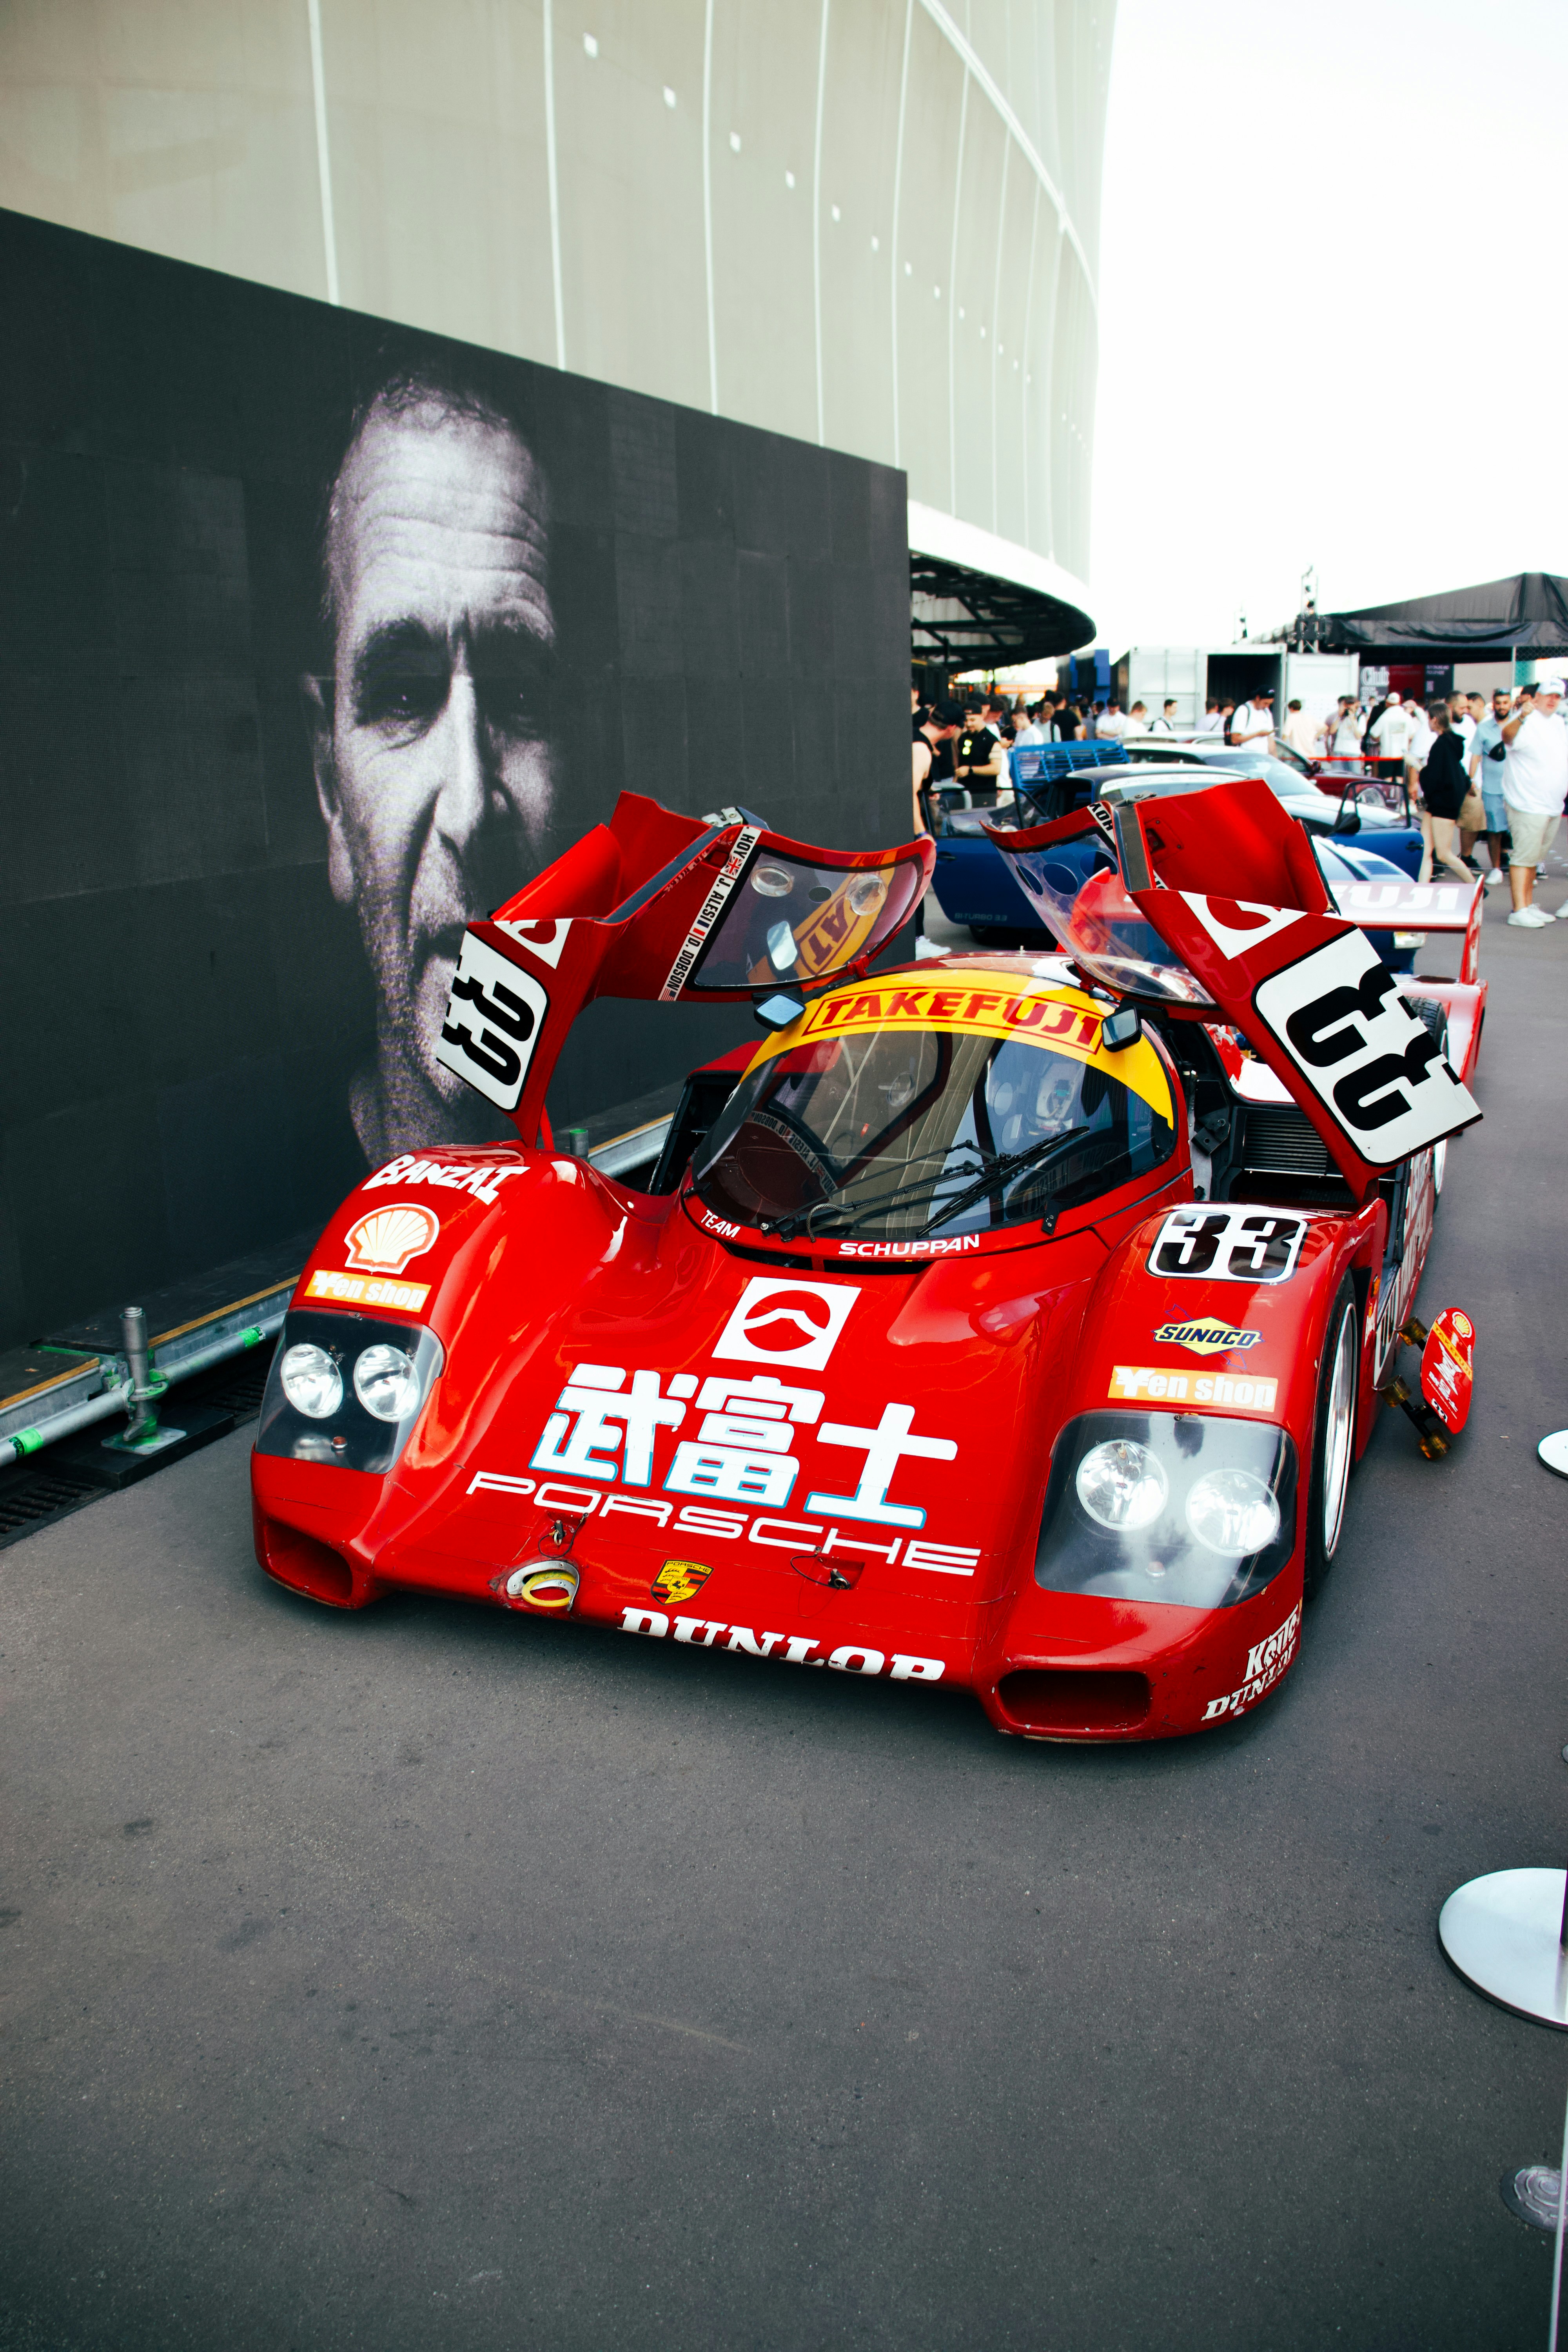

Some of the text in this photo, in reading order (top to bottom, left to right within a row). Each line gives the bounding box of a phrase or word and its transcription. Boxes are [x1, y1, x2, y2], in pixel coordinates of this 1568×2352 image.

[1361, 667, 1389, 686] Club
[1089, 803, 1113, 831] HOY
[733, 834, 755, 859] HOY
[700, 877, 731, 921] J. ALESI
[667, 936, 701, 991] D. DOBSON
[820, 989, 1101, 1045] TAKEFUJI
[361, 1154, 530, 1205] BANZAI
[701, 1209, 980, 1256] TEAM SCHUPPAN
[1156, 1210, 1301, 1279] 33
[365, 1281, 428, 1310] shop
[1161, 1326, 1256, 1346] SUNOCO
[1194, 1376, 1275, 1409] shop
[528, 1363, 958, 1530] 武富士
[466, 1471, 982, 1576] PORSCHE
[666, 1561, 711, 1573] PORSCHE
[616, 1607, 946, 1681] DUNLOP
